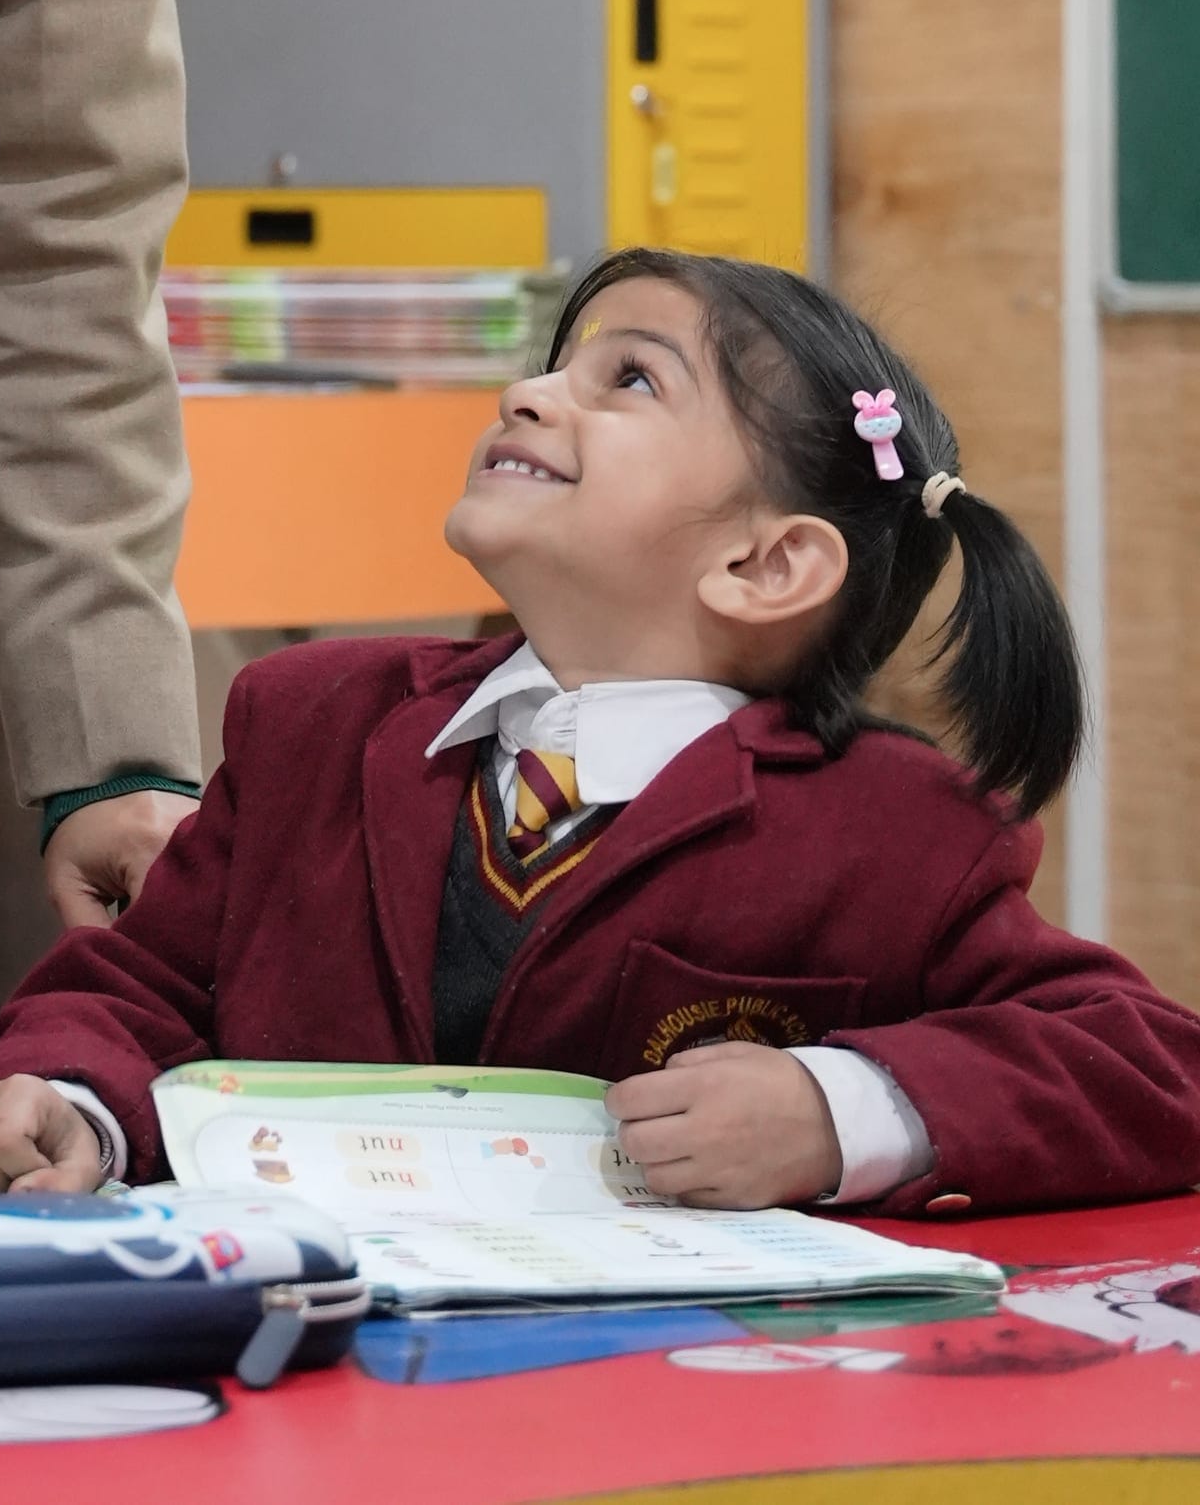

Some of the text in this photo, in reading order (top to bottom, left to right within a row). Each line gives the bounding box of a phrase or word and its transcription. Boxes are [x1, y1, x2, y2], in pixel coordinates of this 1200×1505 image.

[643, 1000, 720, 1066] DALHOUSIE
[725, 995, 788, 1019] PUBLIC
[358, 1135, 404, 1151] nut
[367, 1170, 415, 1187] hut
